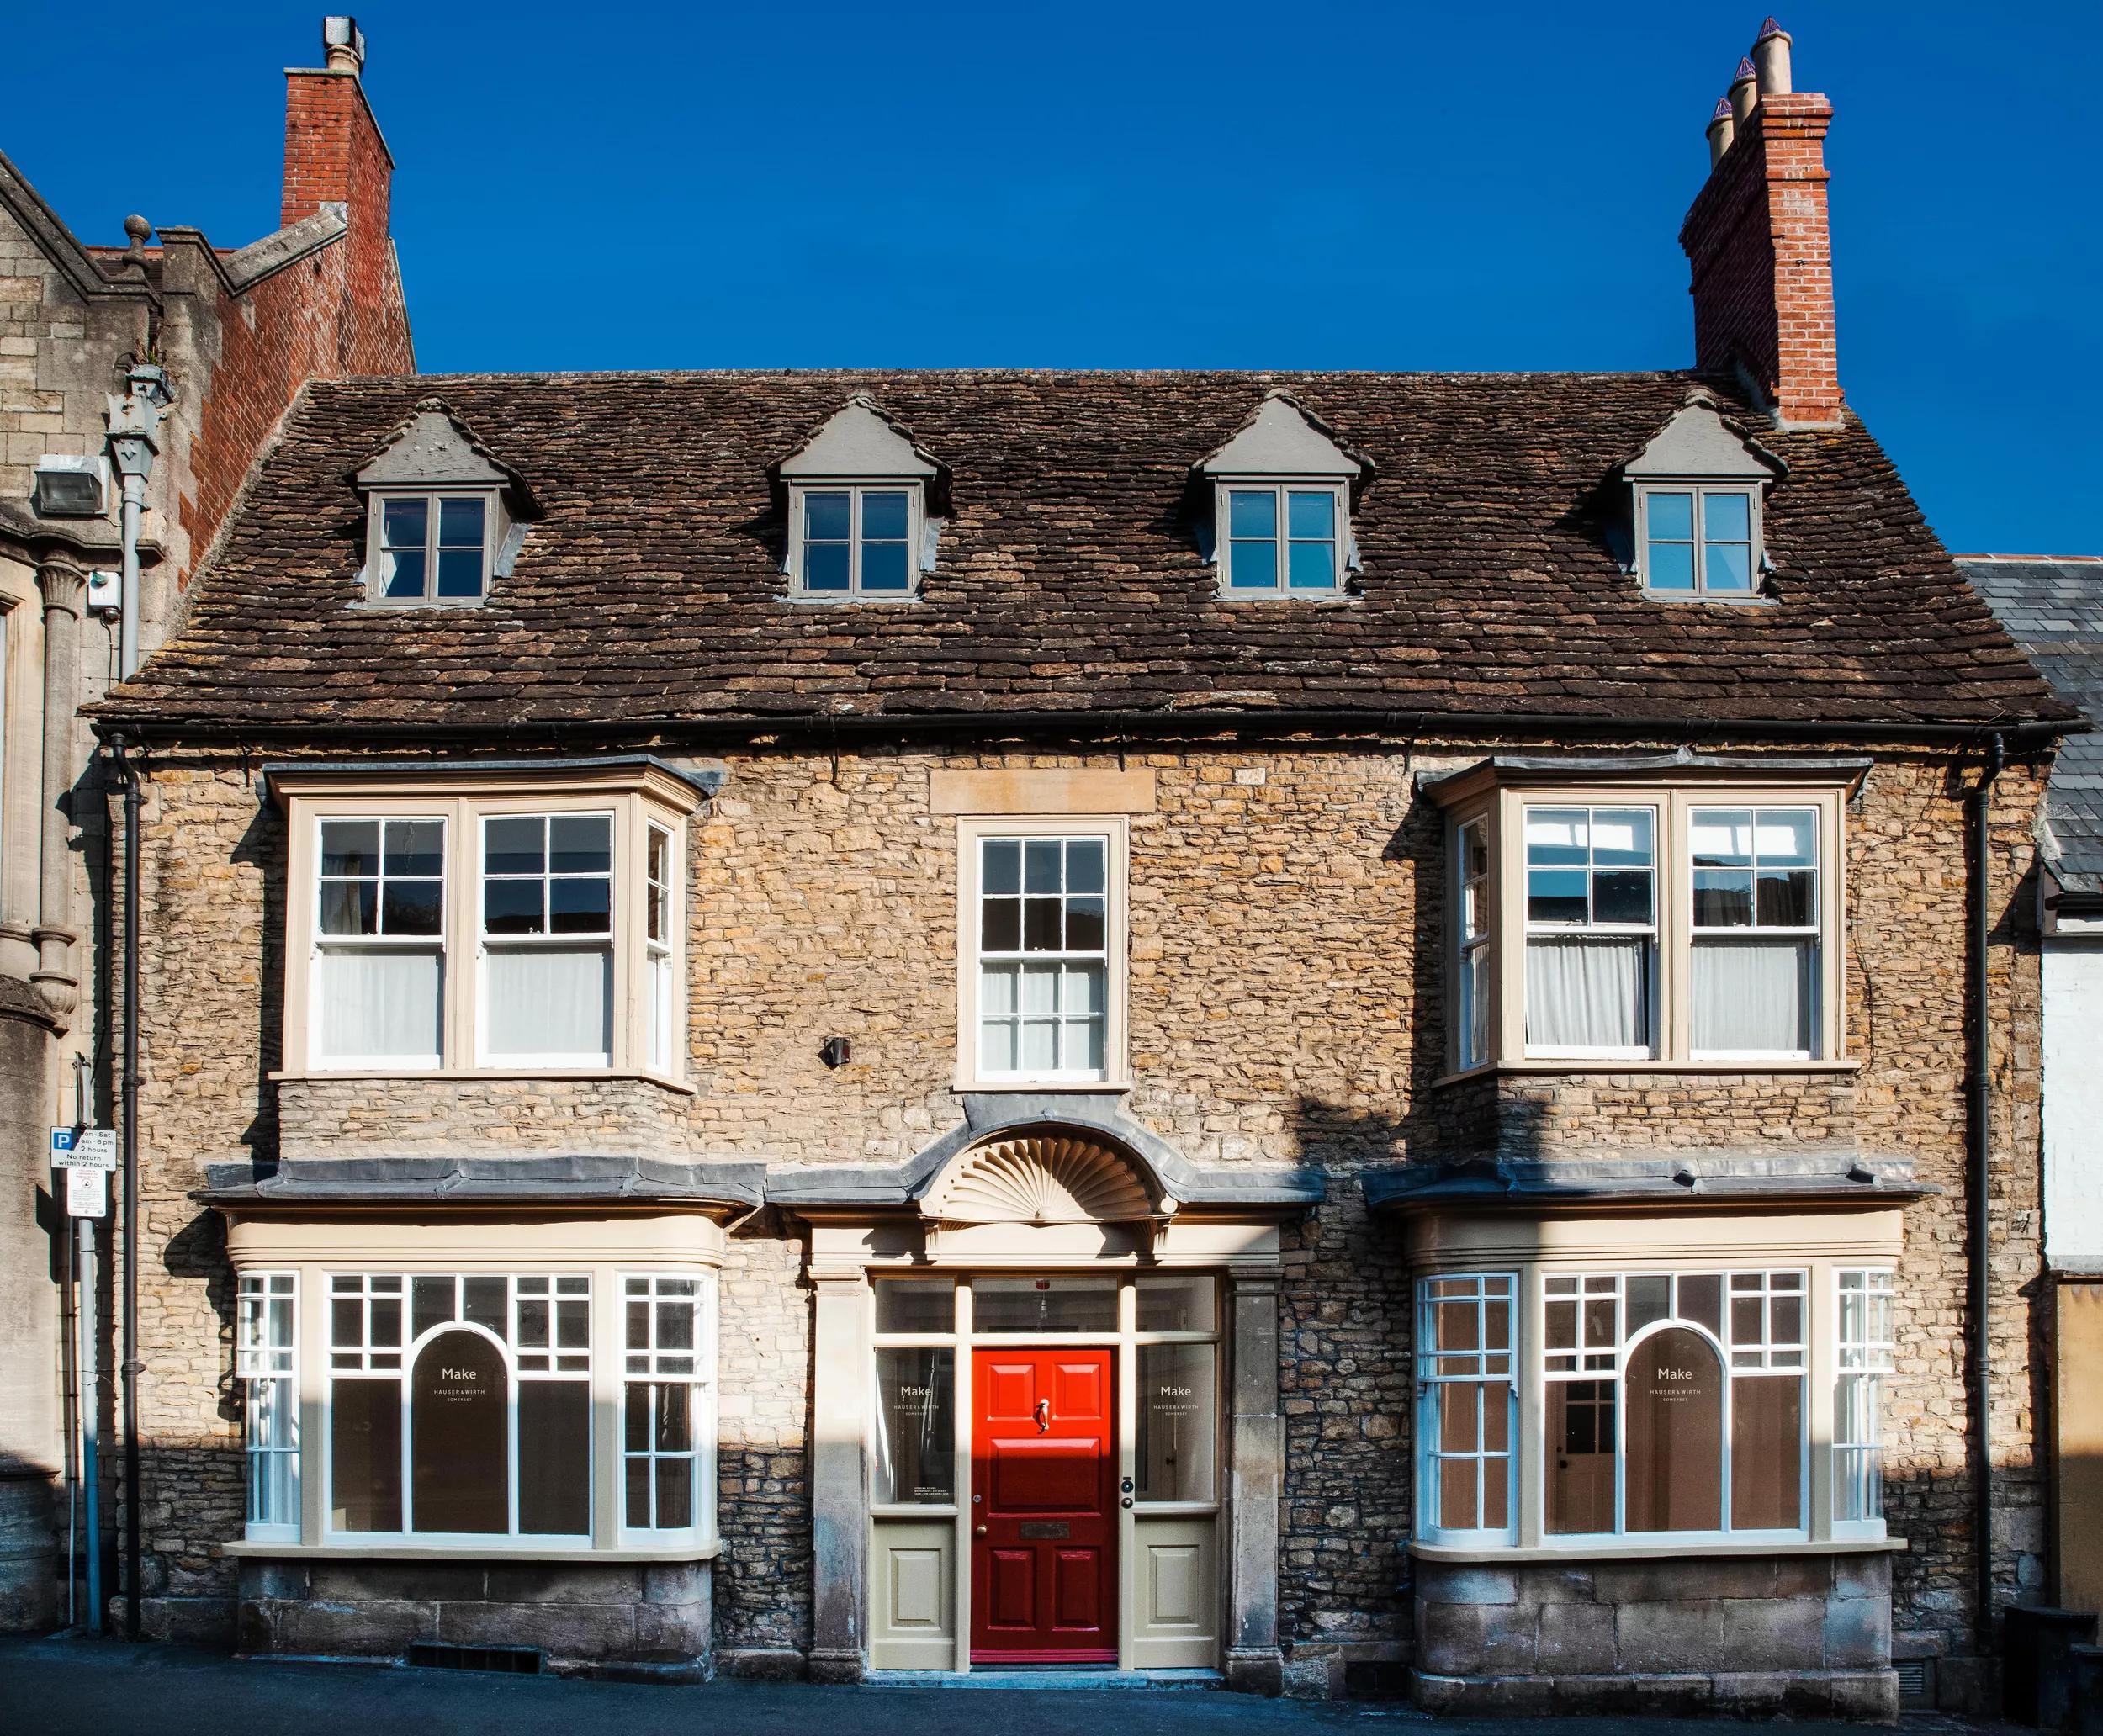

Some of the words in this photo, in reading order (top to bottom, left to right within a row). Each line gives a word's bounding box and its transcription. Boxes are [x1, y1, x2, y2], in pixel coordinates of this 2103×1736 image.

[58, 1135, 70, 1147] P
[442, 1368, 477, 1379] Make
[1657, 1368, 1692, 1379] Make
[901, 1386, 932, 1396] Make
[1161, 1386, 1192, 1396] Make
